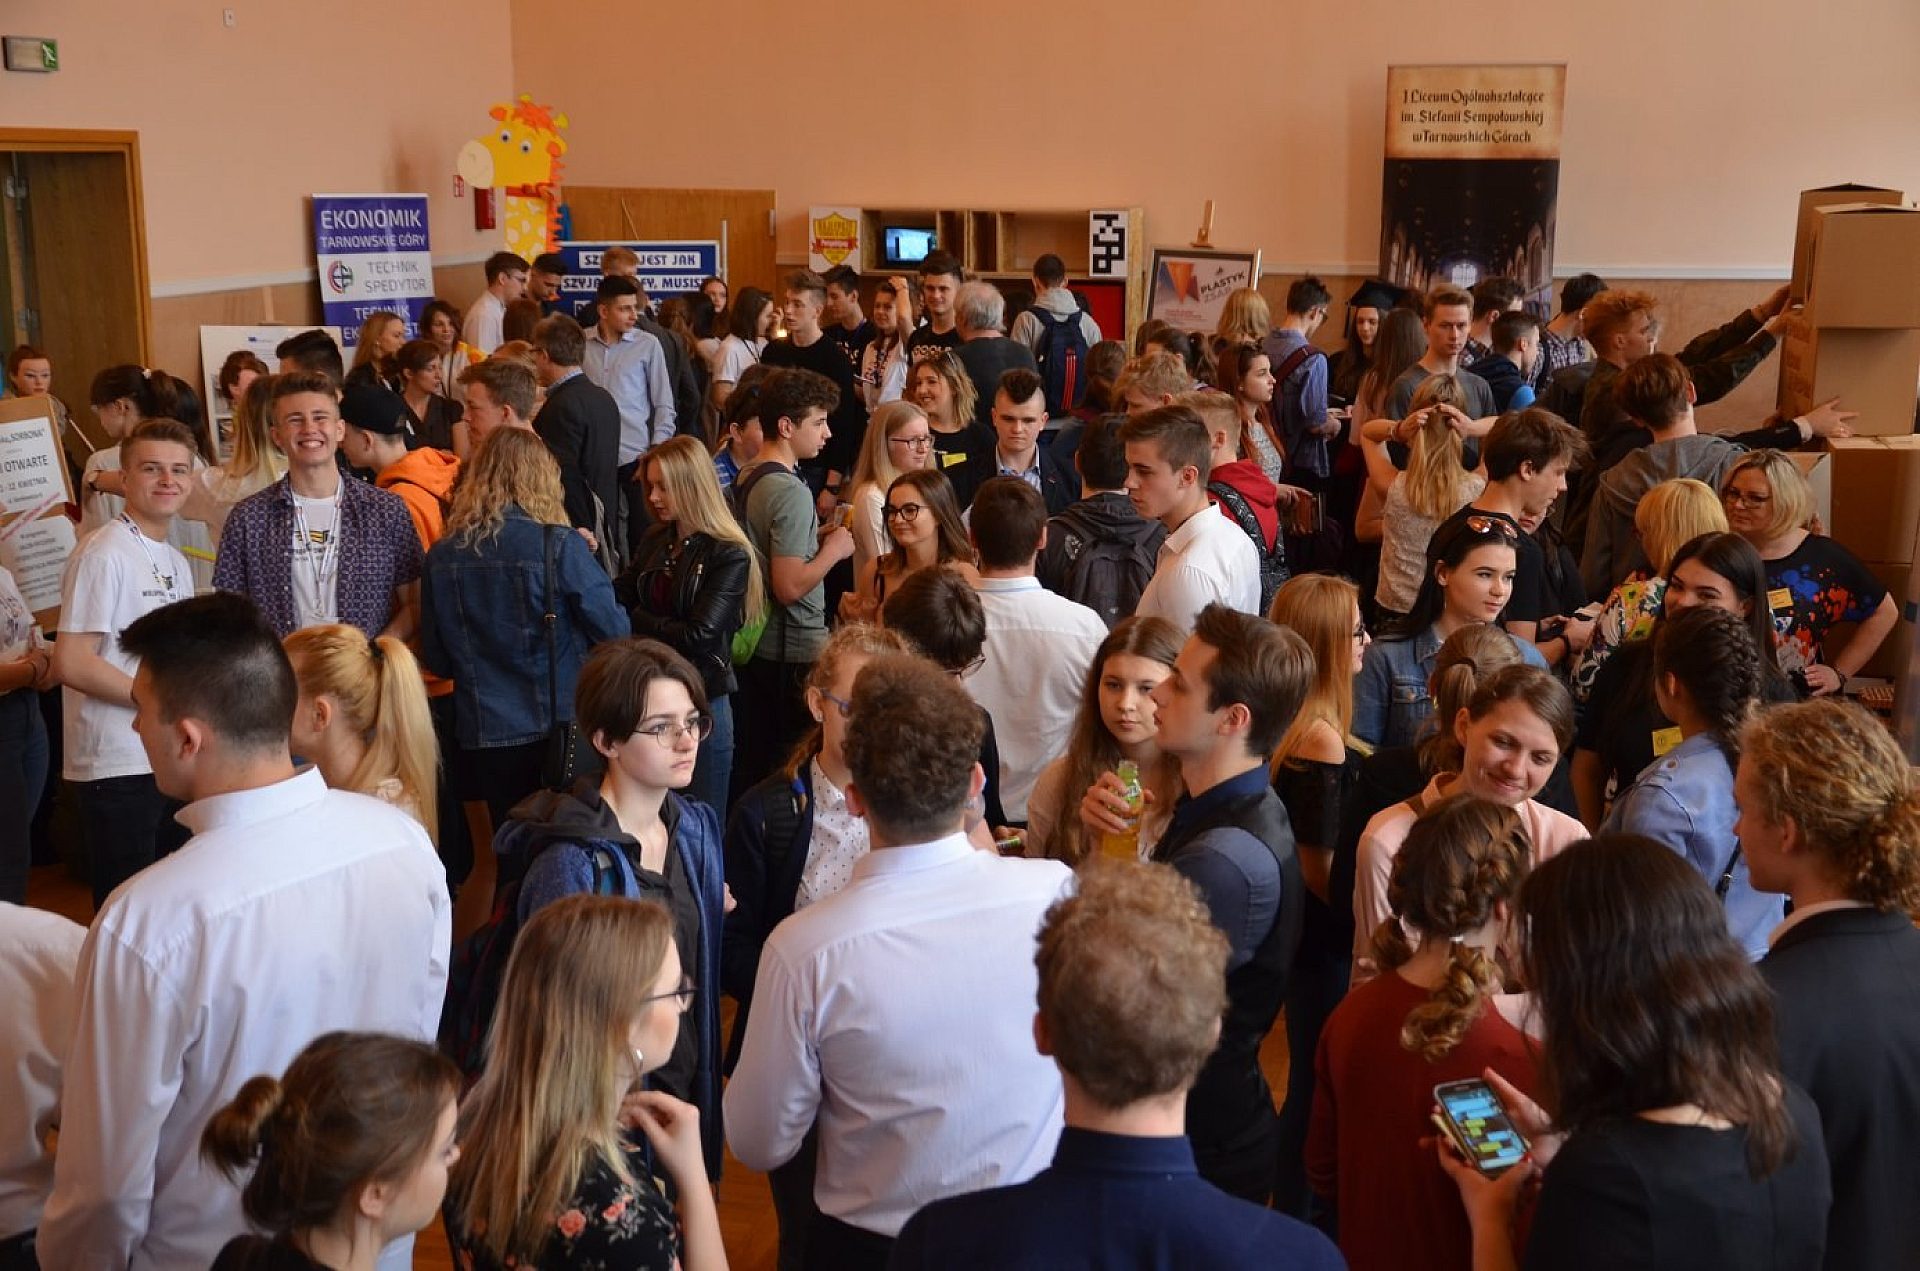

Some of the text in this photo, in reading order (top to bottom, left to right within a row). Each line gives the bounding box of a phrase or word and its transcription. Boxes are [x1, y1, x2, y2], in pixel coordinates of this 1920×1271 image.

[1411, 89, 1450, 103] Liceum
[1419, 110, 1461, 123] Stefanii
[1412, 130, 1532, 144] w Tarnowskich Górach
[320, 208, 422, 230] EKONOMIK
[319, 231, 426, 249] TARNOWSKIE GÓRY
[367, 261, 419, 274] TECHNIK
[639, 254, 668, 266] JEST
[365, 278, 428, 294] SPEDYTOR
[1200, 271, 1245, 294] PLASTYK
[4, 454, 49, 473] OTWARTE
